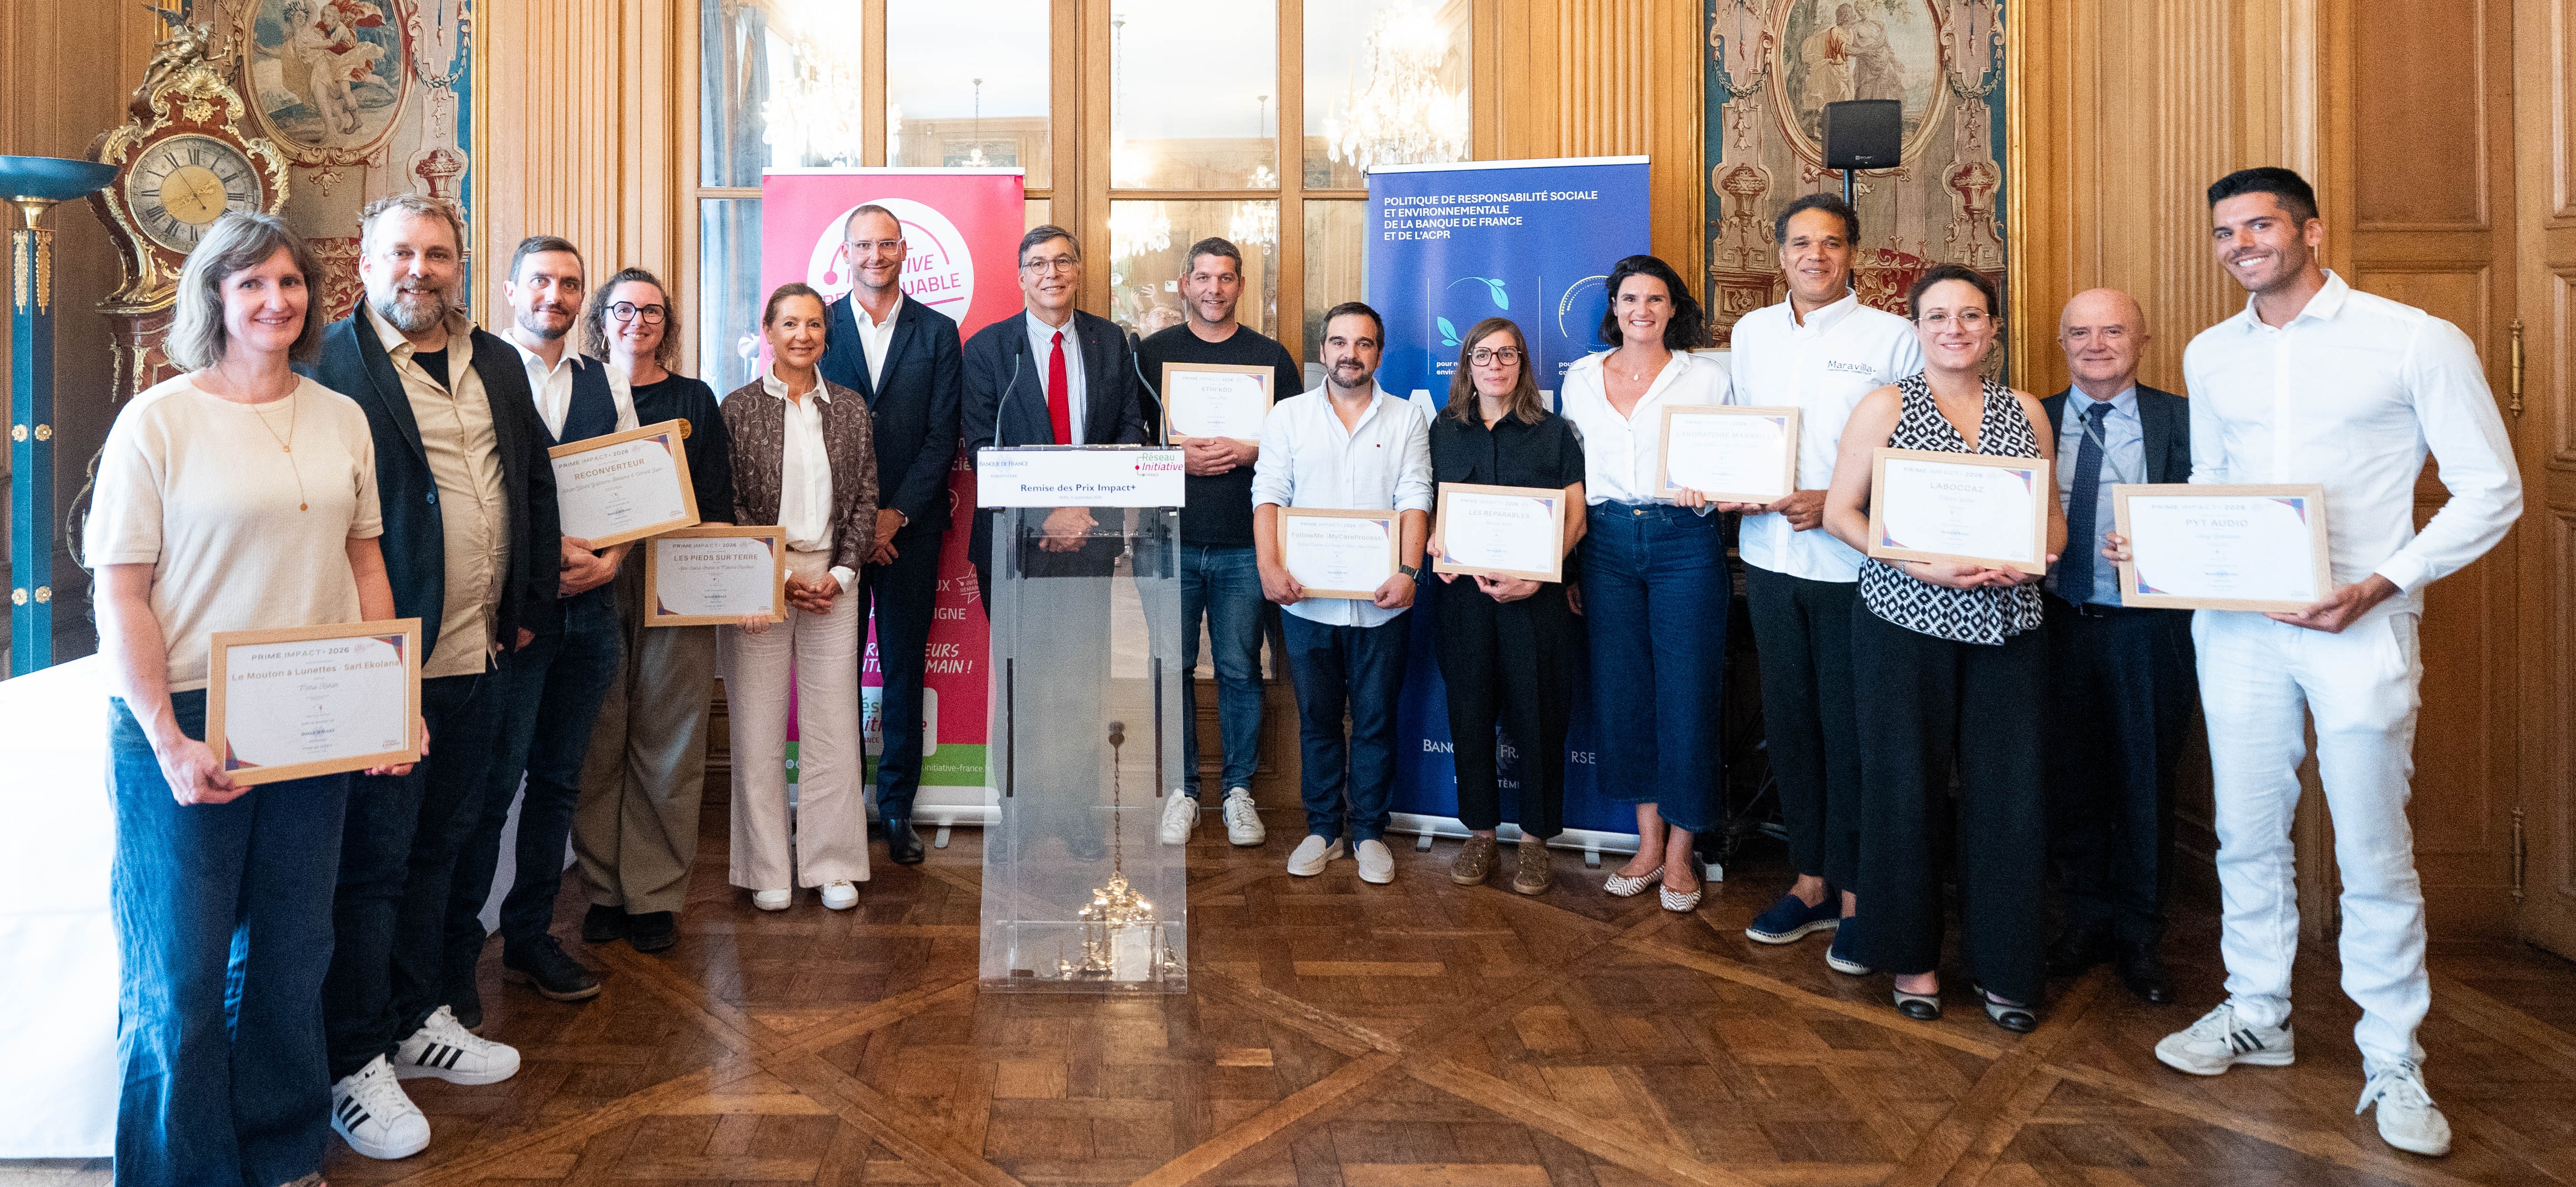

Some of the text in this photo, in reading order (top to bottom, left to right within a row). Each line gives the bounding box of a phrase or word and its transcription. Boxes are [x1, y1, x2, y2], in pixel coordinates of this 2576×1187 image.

[1384, 190, 1598, 206] POLITIQUE DE RESPONSABILITÉ SOCIALE
[1384, 205, 1509, 218] ET ENVIRONNEMENTALE
[1384, 217, 1523, 229] DE LA BANQUE DE FRANCE
[1384, 230, 1450, 240] ET DE L’ACPR
[1142, 453, 1175, 461] Réseau
[559, 460, 580, 469] PRIME
[575, 458, 645, 480] RECONVERTEUR
[1142, 462, 1183, 471] Initiative
[1098, 484, 1136, 493] Impact+
[1930, 482, 1985, 493] LABOCCAZ
[2186, 518, 2248, 527] PYT AUDIO
[252, 652, 282, 660] PRIME
[328, 647, 350, 655] 2026
[232, 673, 244, 681] Le
[247, 670, 284, 680] Mouton
[295, 666, 336, 676] Lunettes
[365, 659, 399, 669] Ekolana
[1571, 751, 1596, 765] RSE
